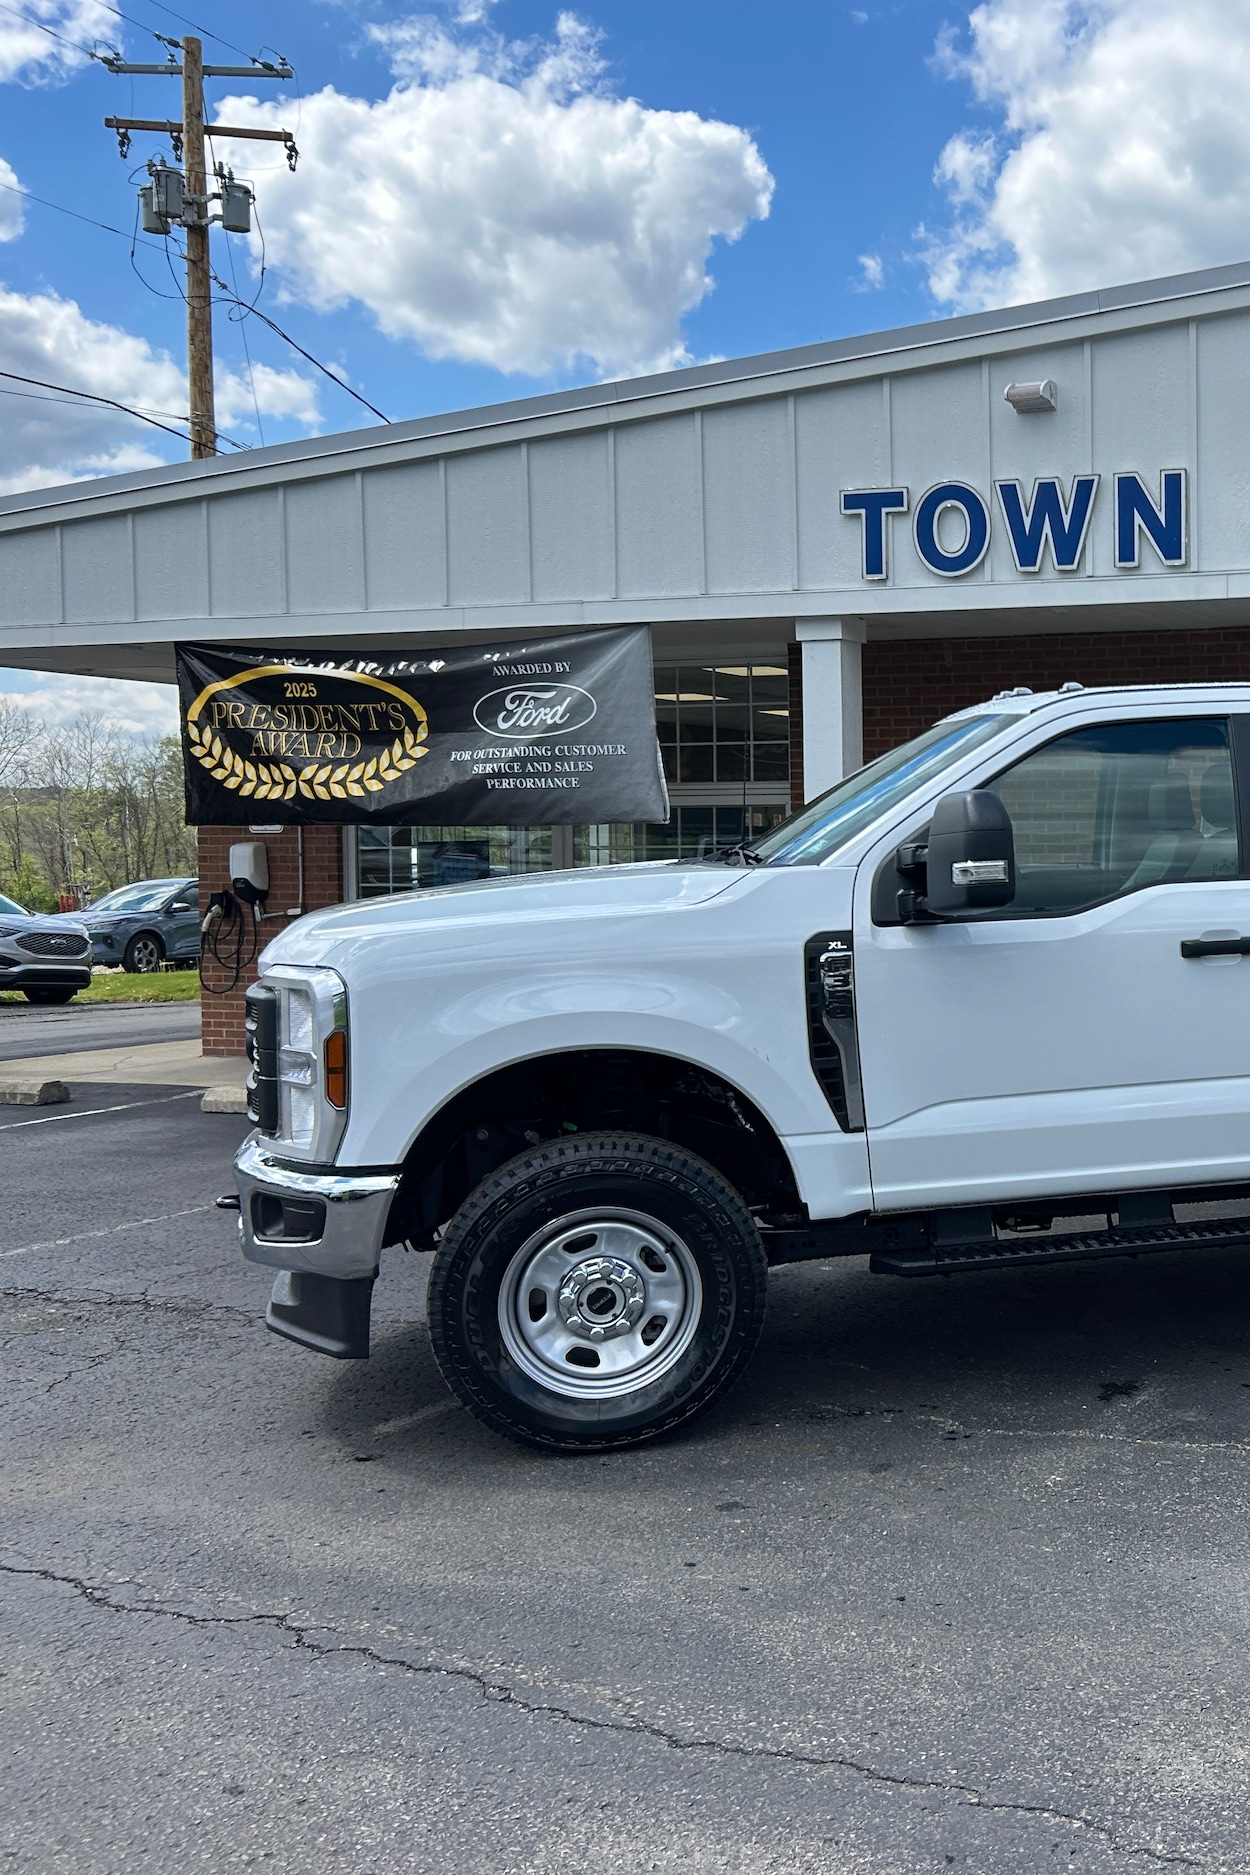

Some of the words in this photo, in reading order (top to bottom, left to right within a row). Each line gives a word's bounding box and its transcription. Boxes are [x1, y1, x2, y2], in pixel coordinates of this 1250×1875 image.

[840, 468, 1188, 580] TOWN
[492, 663, 552, 677] AWARDED
[555, 661, 572, 673] BY
[283, 682, 318, 698] 2025
[211, 702, 406, 733] PRESIDENT'S
[497, 690, 572, 730] Ford
[249, 731, 362, 759] AWARD
[450, 751, 472, 762] FOR
[473, 746, 551, 760] OUTSTANDING
[555, 744, 627, 757] CUSTOMER
[472, 762, 522, 775] SERVICE
[525, 761, 552, 773] AND
[555, 761, 594, 773] SALES
[486, 777, 580, 789] PERFORMANCE
[828, 941, 848, 950] XL
